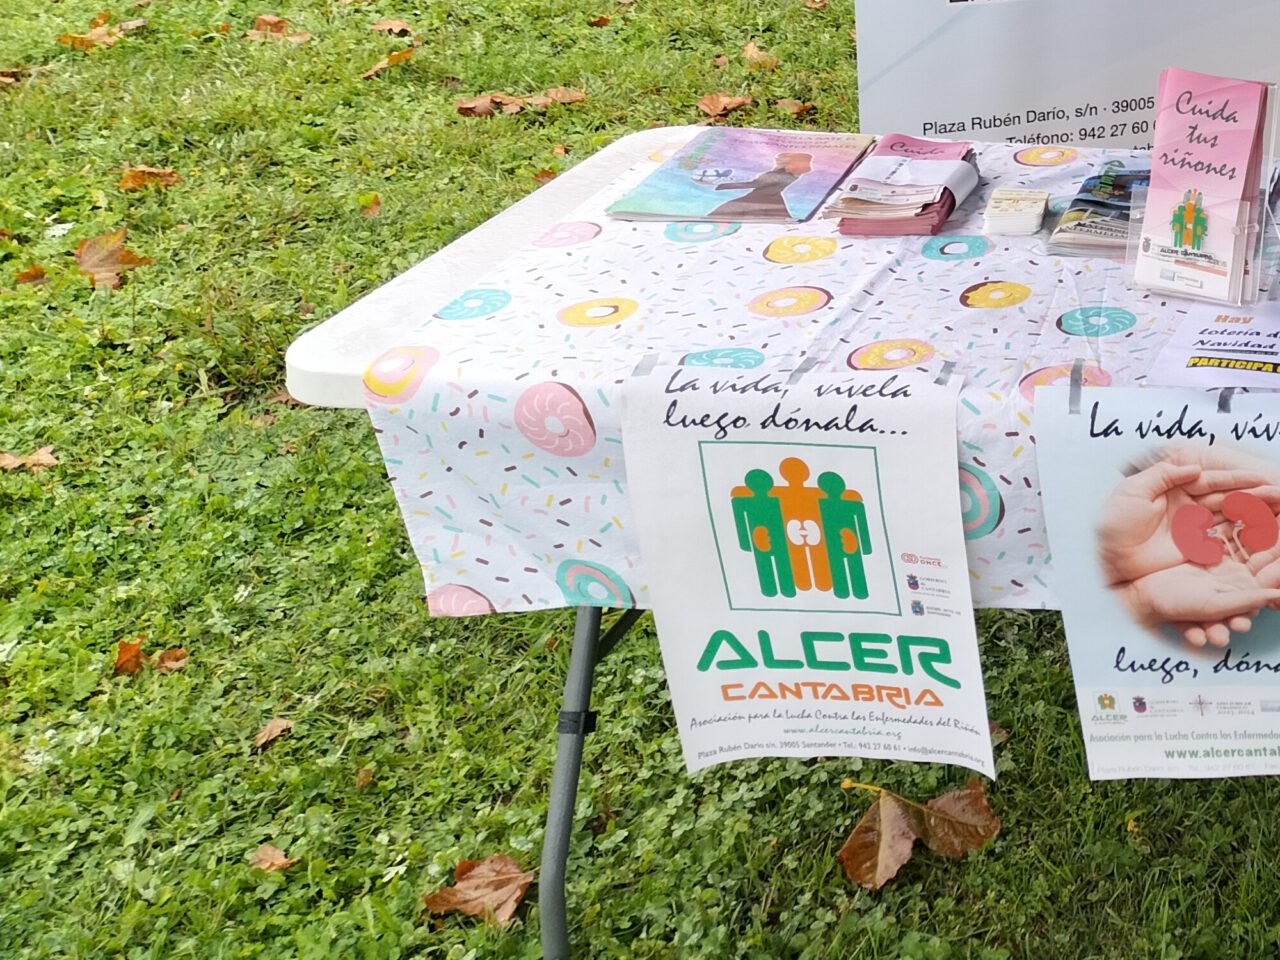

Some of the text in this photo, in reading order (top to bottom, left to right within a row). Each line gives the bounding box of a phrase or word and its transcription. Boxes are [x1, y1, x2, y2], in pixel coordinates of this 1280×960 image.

[923, 97, 1155, 136] Plaza Rubén Darío, s/n 39005
[1176, 91, 1238, 122] Cuida
[1079, 119, 1148, 139] 942 27 60
[1186, 124, 1218, 148] tus
[1159, 149, 1236, 180] riñones
[1199, 328, 1261, 337] Lotería
[1215, 314, 1254, 325] Hay
[1192, 339, 1276, 349] Navidad
[1188, 357, 1273, 372] PARTICIPA
[665, 369, 911, 399] La vida, vívela
[663, 399, 908, 440] luego dónala...
[1090, 401, 1124, 440] La
[1135, 404, 1216, 446] vida,
[697, 629, 961, 690] ALCER
[1114, 647, 1200, 684] luego,
[721, 681, 944, 709] CANTABRIA
